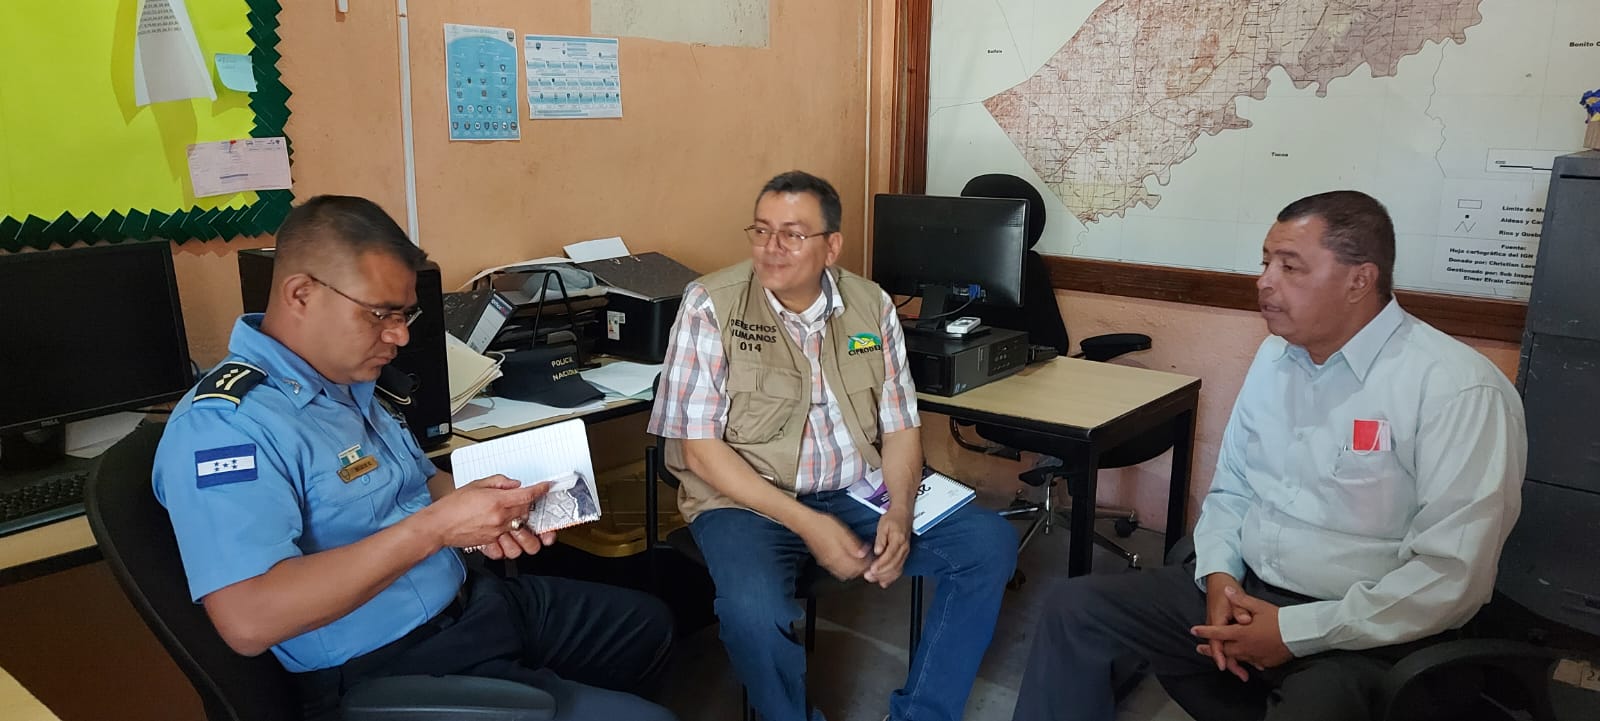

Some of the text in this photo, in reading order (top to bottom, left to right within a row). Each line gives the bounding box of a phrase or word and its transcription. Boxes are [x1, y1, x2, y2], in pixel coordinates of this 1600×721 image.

[1489, 260, 1519, 268] Christian
[1446, 266, 1484, 275] Gestionado
[730, 318, 777, 333] DERECHOS
[740, 341, 762, 352] 014
